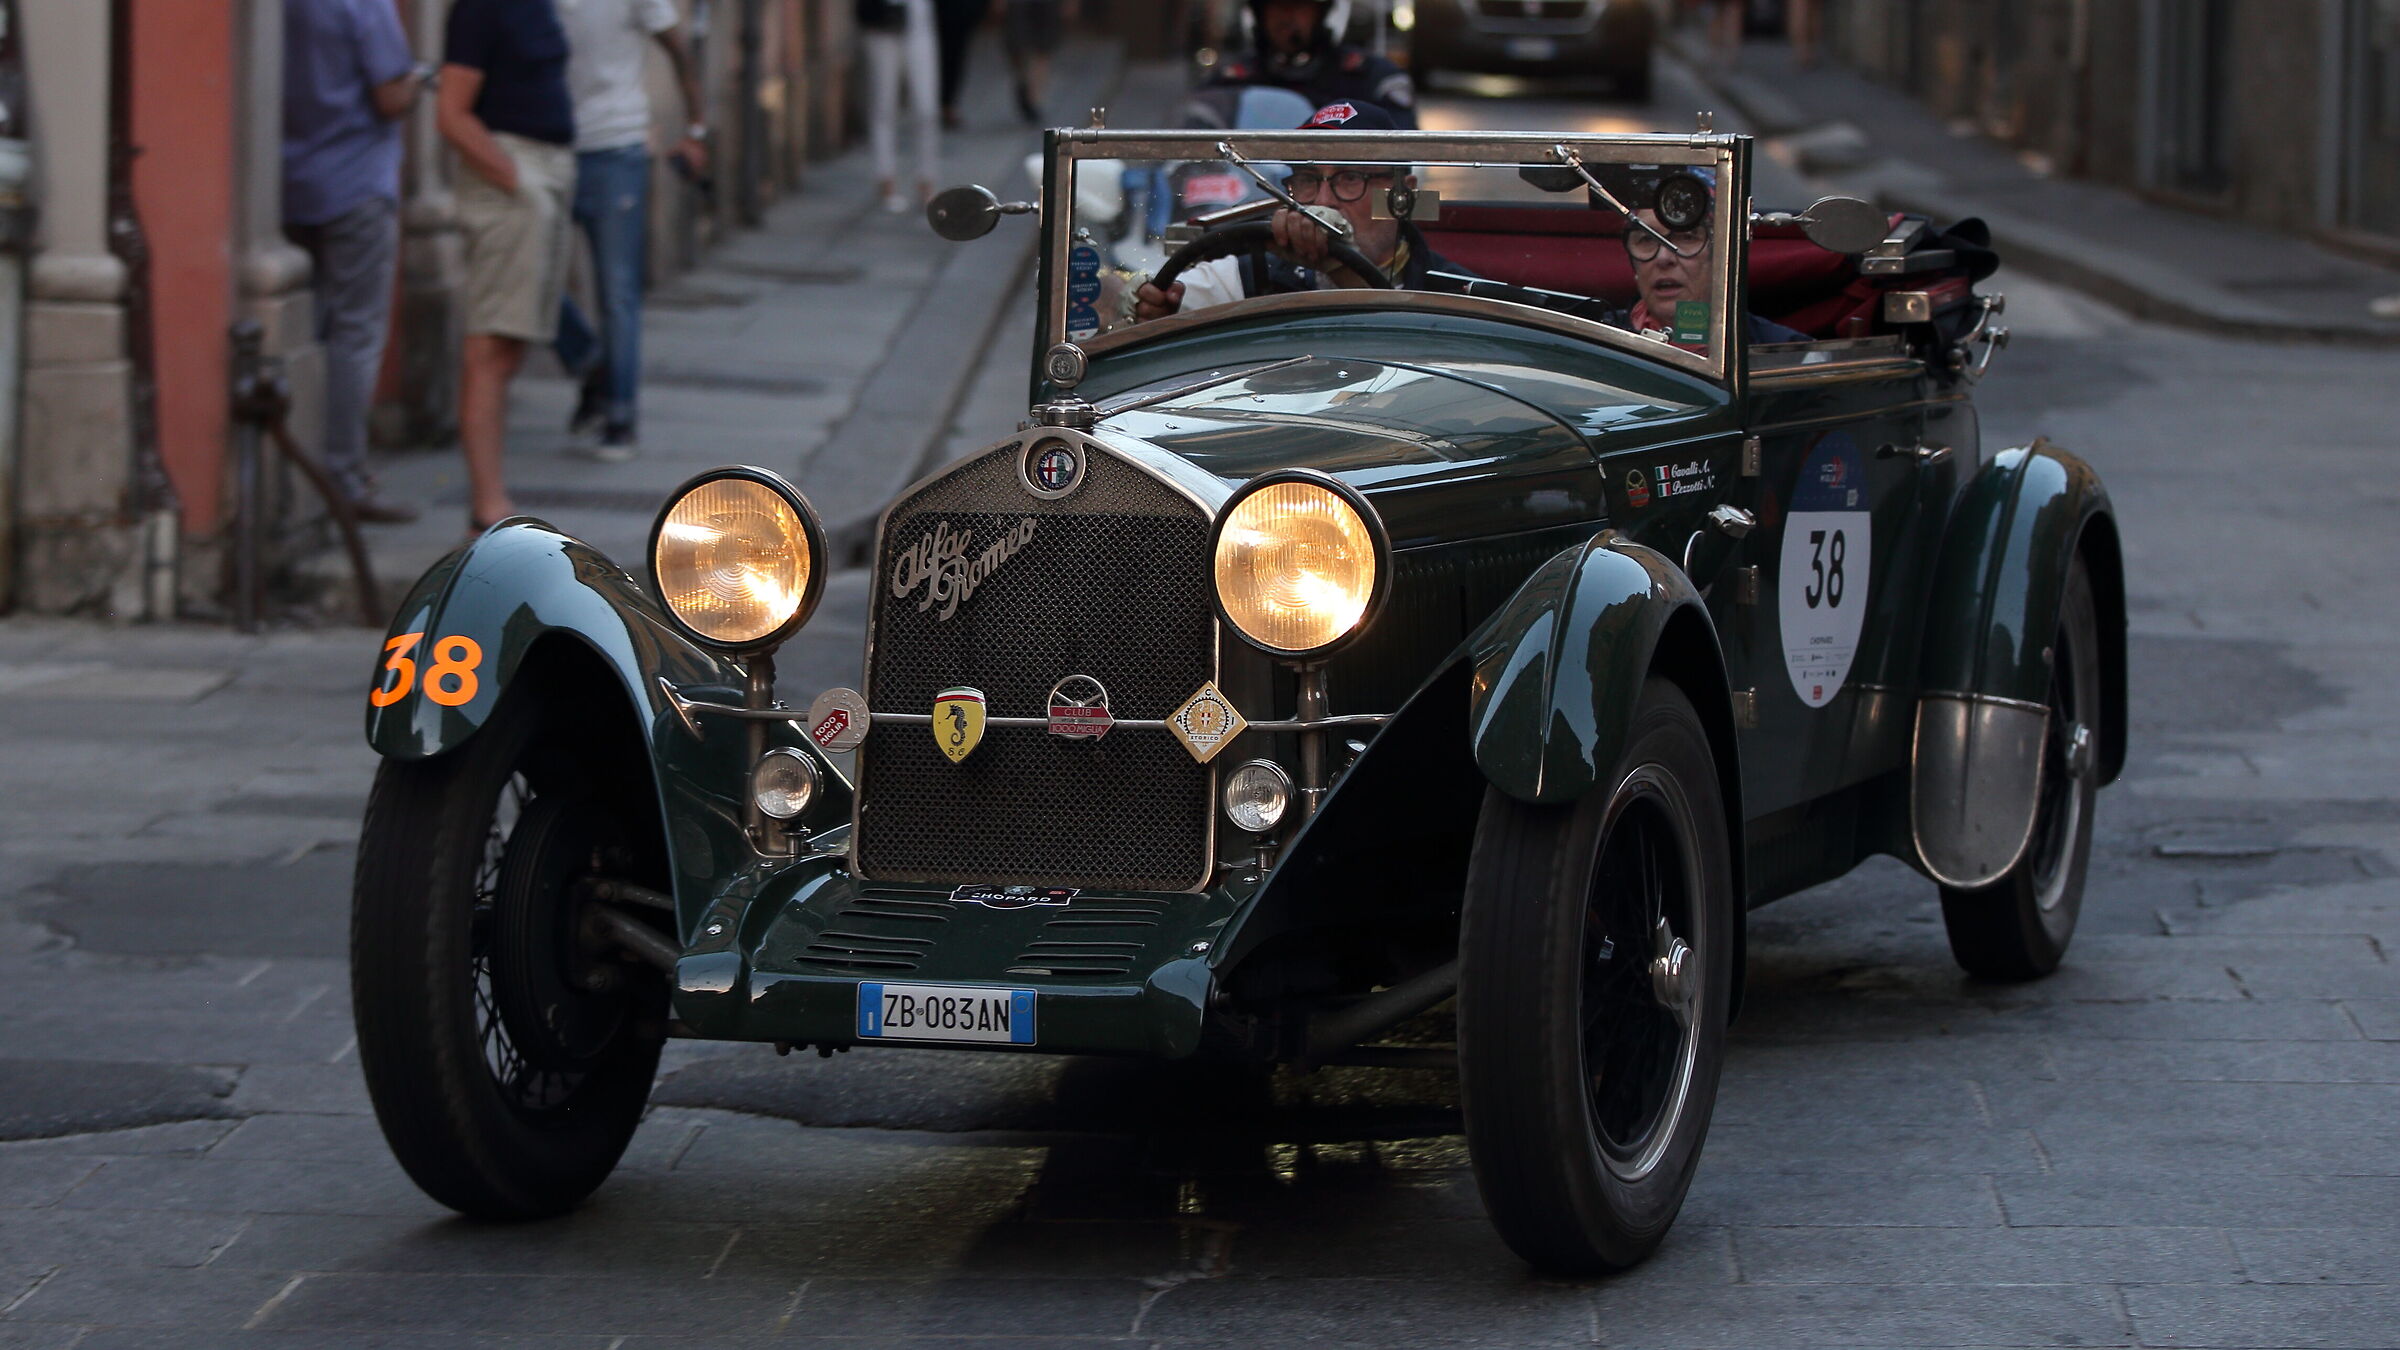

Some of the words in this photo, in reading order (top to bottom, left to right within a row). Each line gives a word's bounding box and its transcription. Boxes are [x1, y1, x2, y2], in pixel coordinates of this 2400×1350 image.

[1671, 461, 1699, 478] Cavalli
[1672, 480, 1703, 495] Pezzotti
[893, 521, 972, 613] Alfa
[934, 518, 1037, 621] Romeo
[1805, 529, 1846, 609] 38
[370, 632, 483, 707] 38
[1064, 708, 1092, 717] CLUB
[815, 716, 836, 736] 1000
[820, 722, 844, 745] MIGLIA
[971, 892, 1052, 902] CHOPARD
